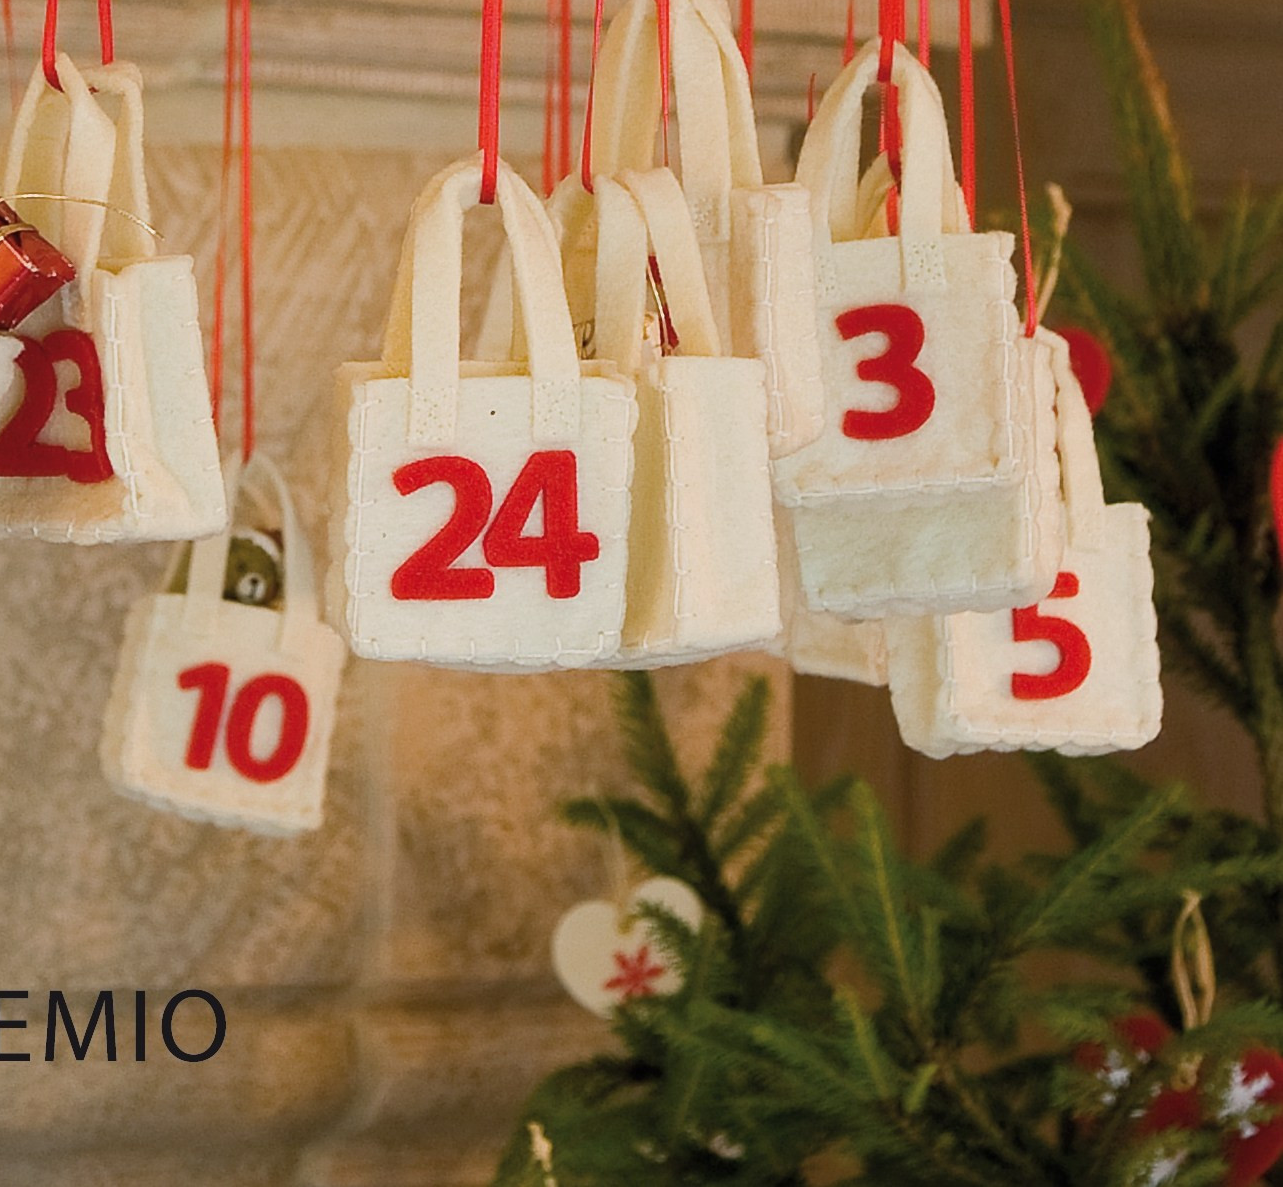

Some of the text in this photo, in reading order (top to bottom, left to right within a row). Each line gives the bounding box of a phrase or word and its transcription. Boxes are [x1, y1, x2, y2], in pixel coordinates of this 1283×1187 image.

[834, 303, 937, 442] 3
[390, 449, 601, 602] 24
[1010, 570, 1093, 702] 5
[177, 661, 311, 785] 10
